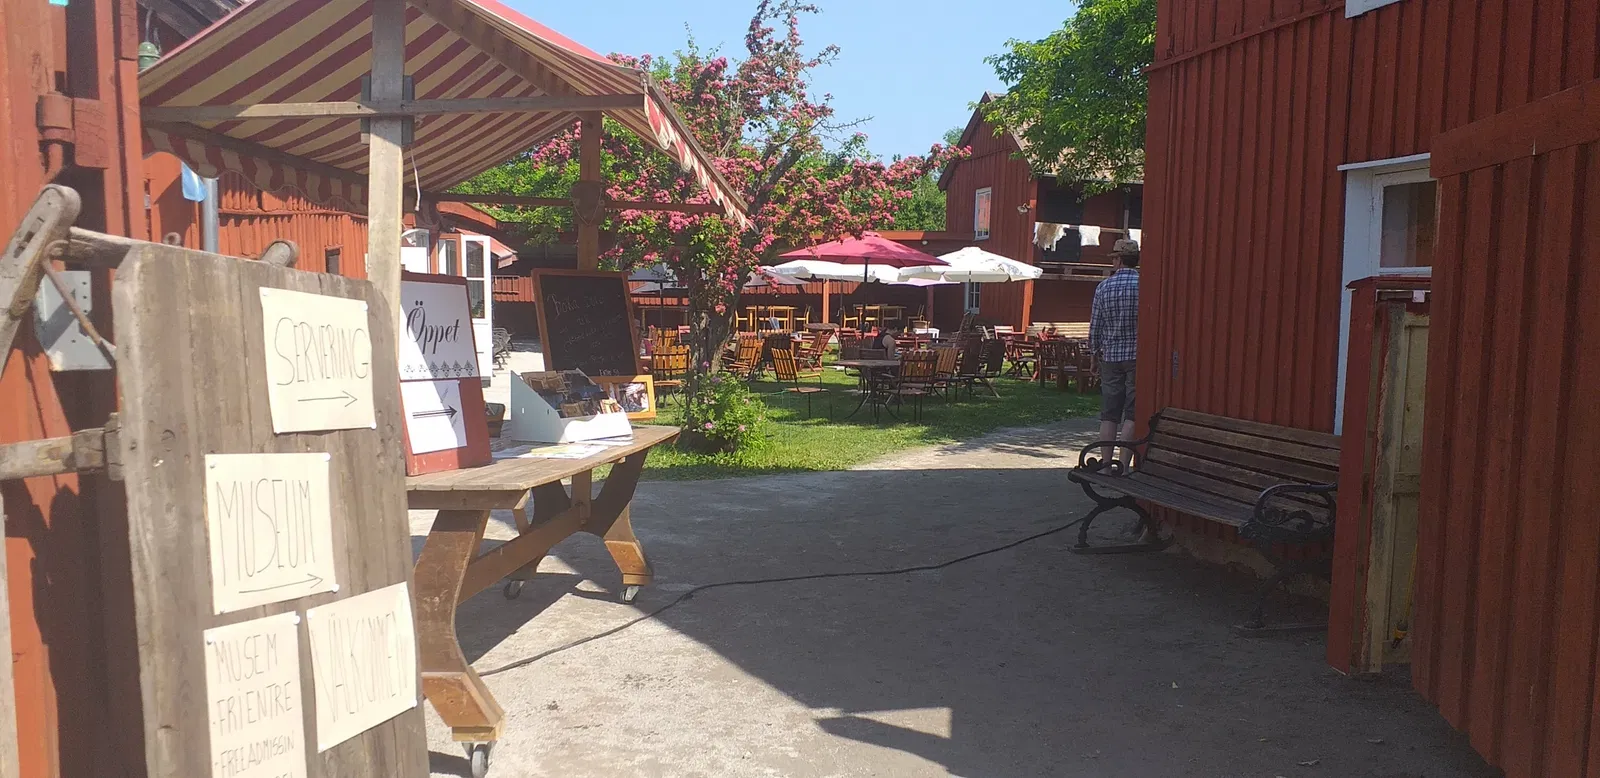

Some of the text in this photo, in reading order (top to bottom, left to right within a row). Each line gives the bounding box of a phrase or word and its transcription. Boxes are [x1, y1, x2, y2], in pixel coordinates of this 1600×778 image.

[274, 316, 369, 385] SERVERING
[406, 300, 460, 355] Öppet
[216, 478, 316, 586] MUSEUM
[213, 633, 278, 683] MUSEM
[246, 681, 293, 725] ENTRE
[220, 746, 247, 778] FREE
